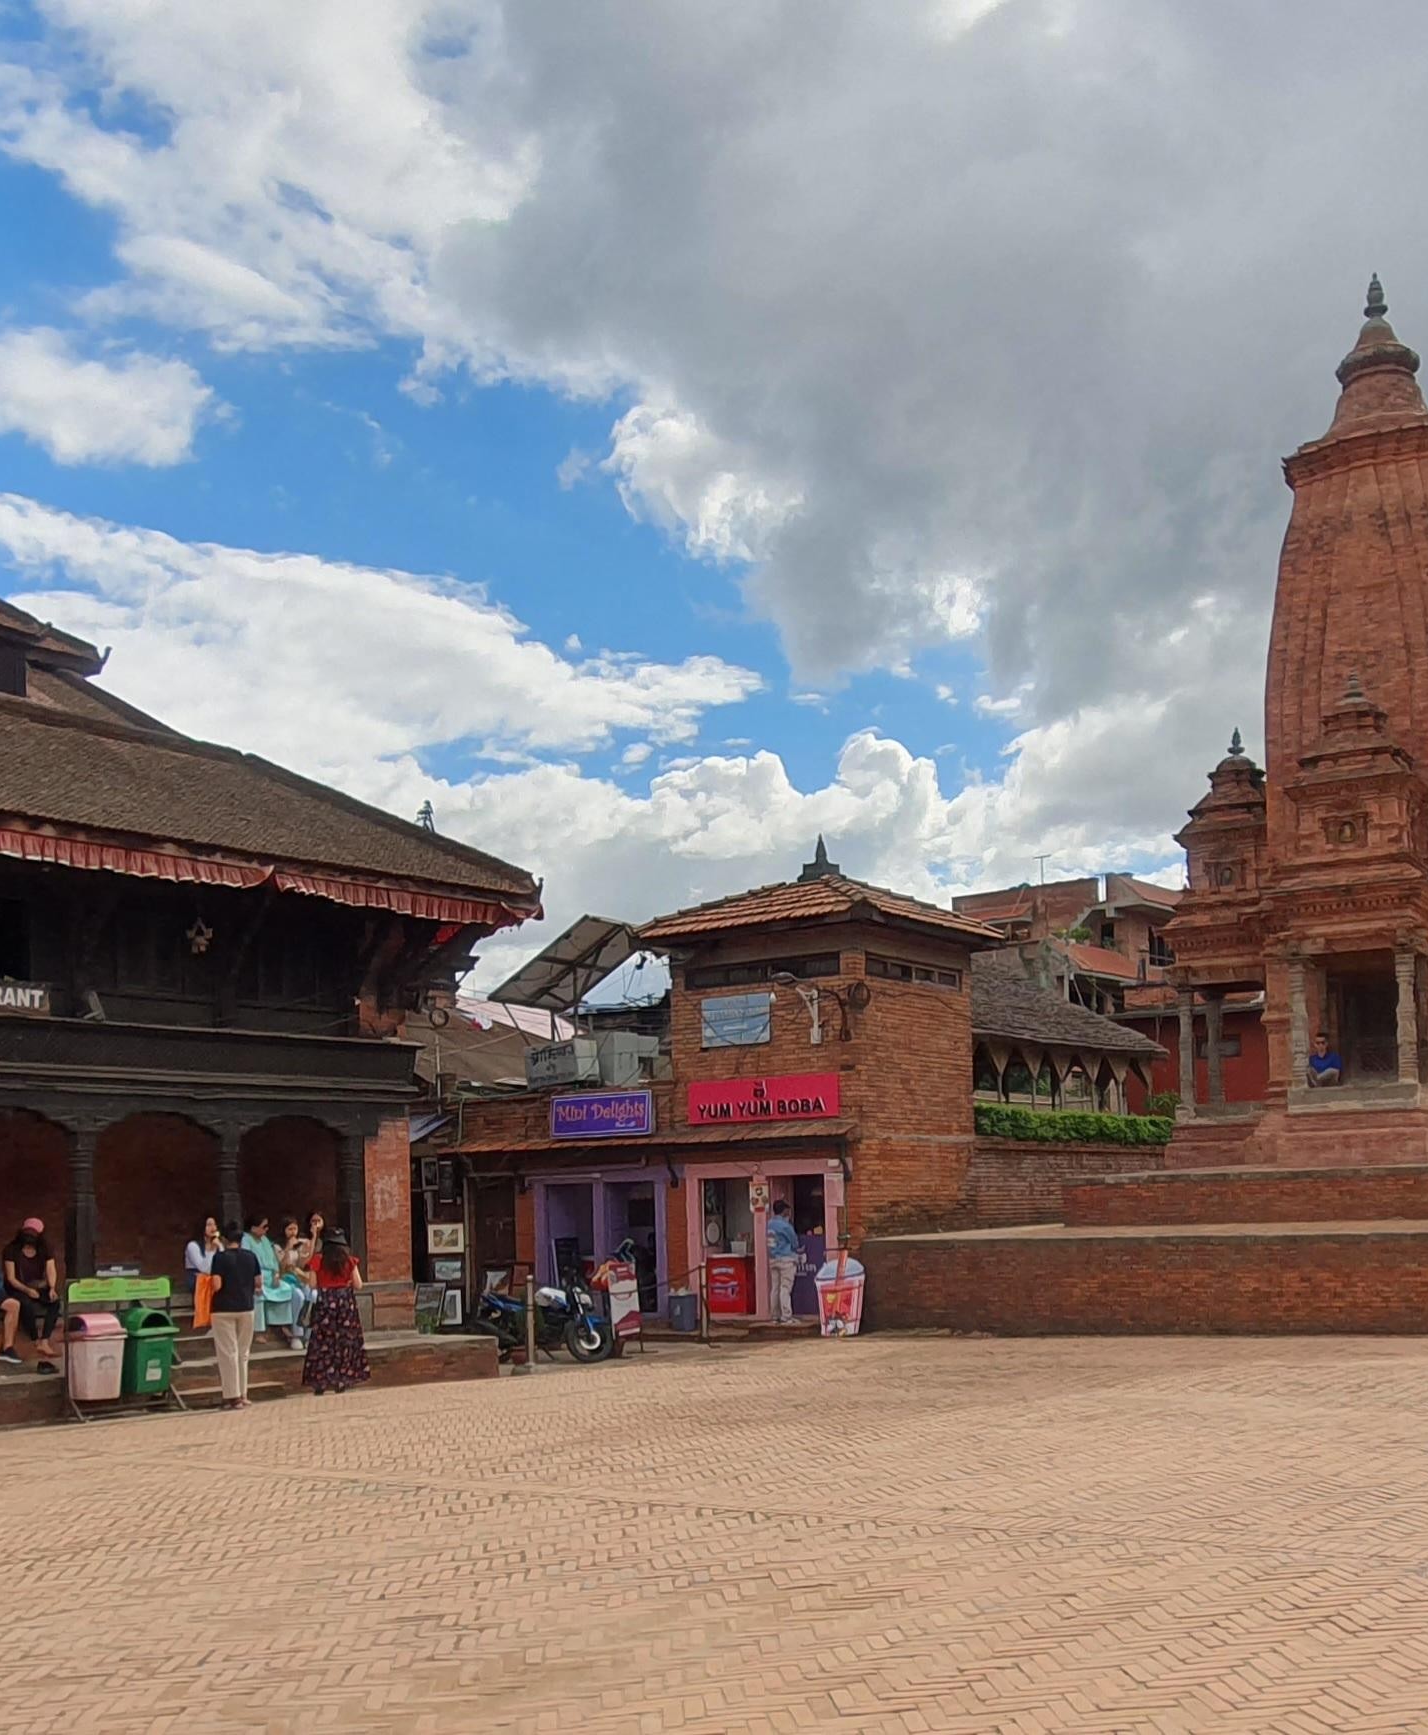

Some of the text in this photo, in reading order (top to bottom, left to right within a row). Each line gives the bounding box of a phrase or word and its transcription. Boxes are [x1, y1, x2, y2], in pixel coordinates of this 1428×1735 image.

[556, 1099, 645, 1122] Mini Delights
[697, 1096, 828, 1119] YUM YUM BOBA
